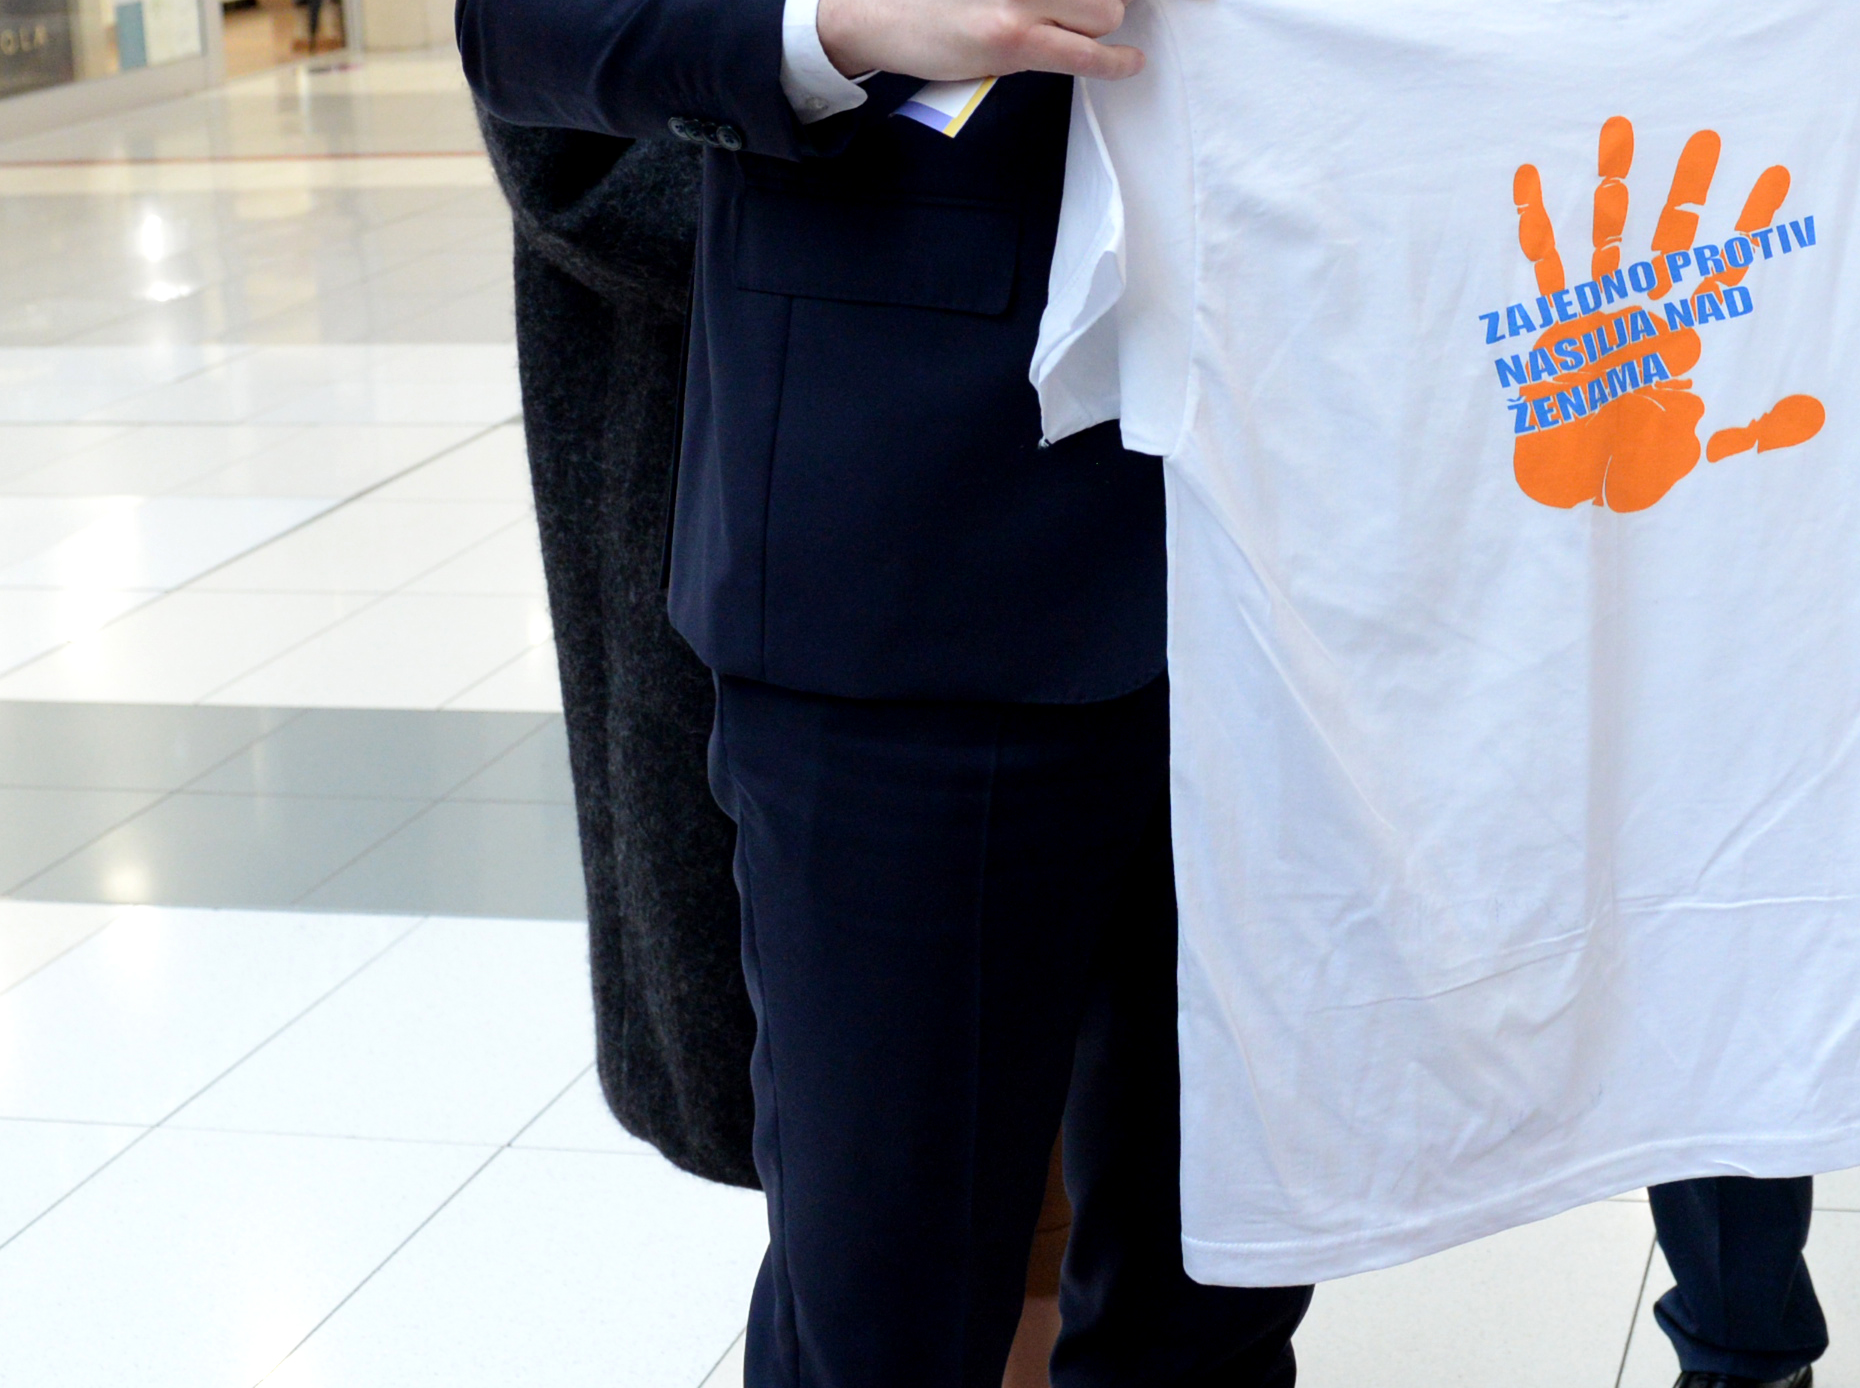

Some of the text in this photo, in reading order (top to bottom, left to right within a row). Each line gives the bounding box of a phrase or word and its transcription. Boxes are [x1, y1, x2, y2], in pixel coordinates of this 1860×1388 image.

[1478, 214, 1817, 345] ZAJEDNO PROTIV
[1494, 285, 1754, 389] NASILJA NAD
[1506, 351, 1671, 435] ŽENAMA
